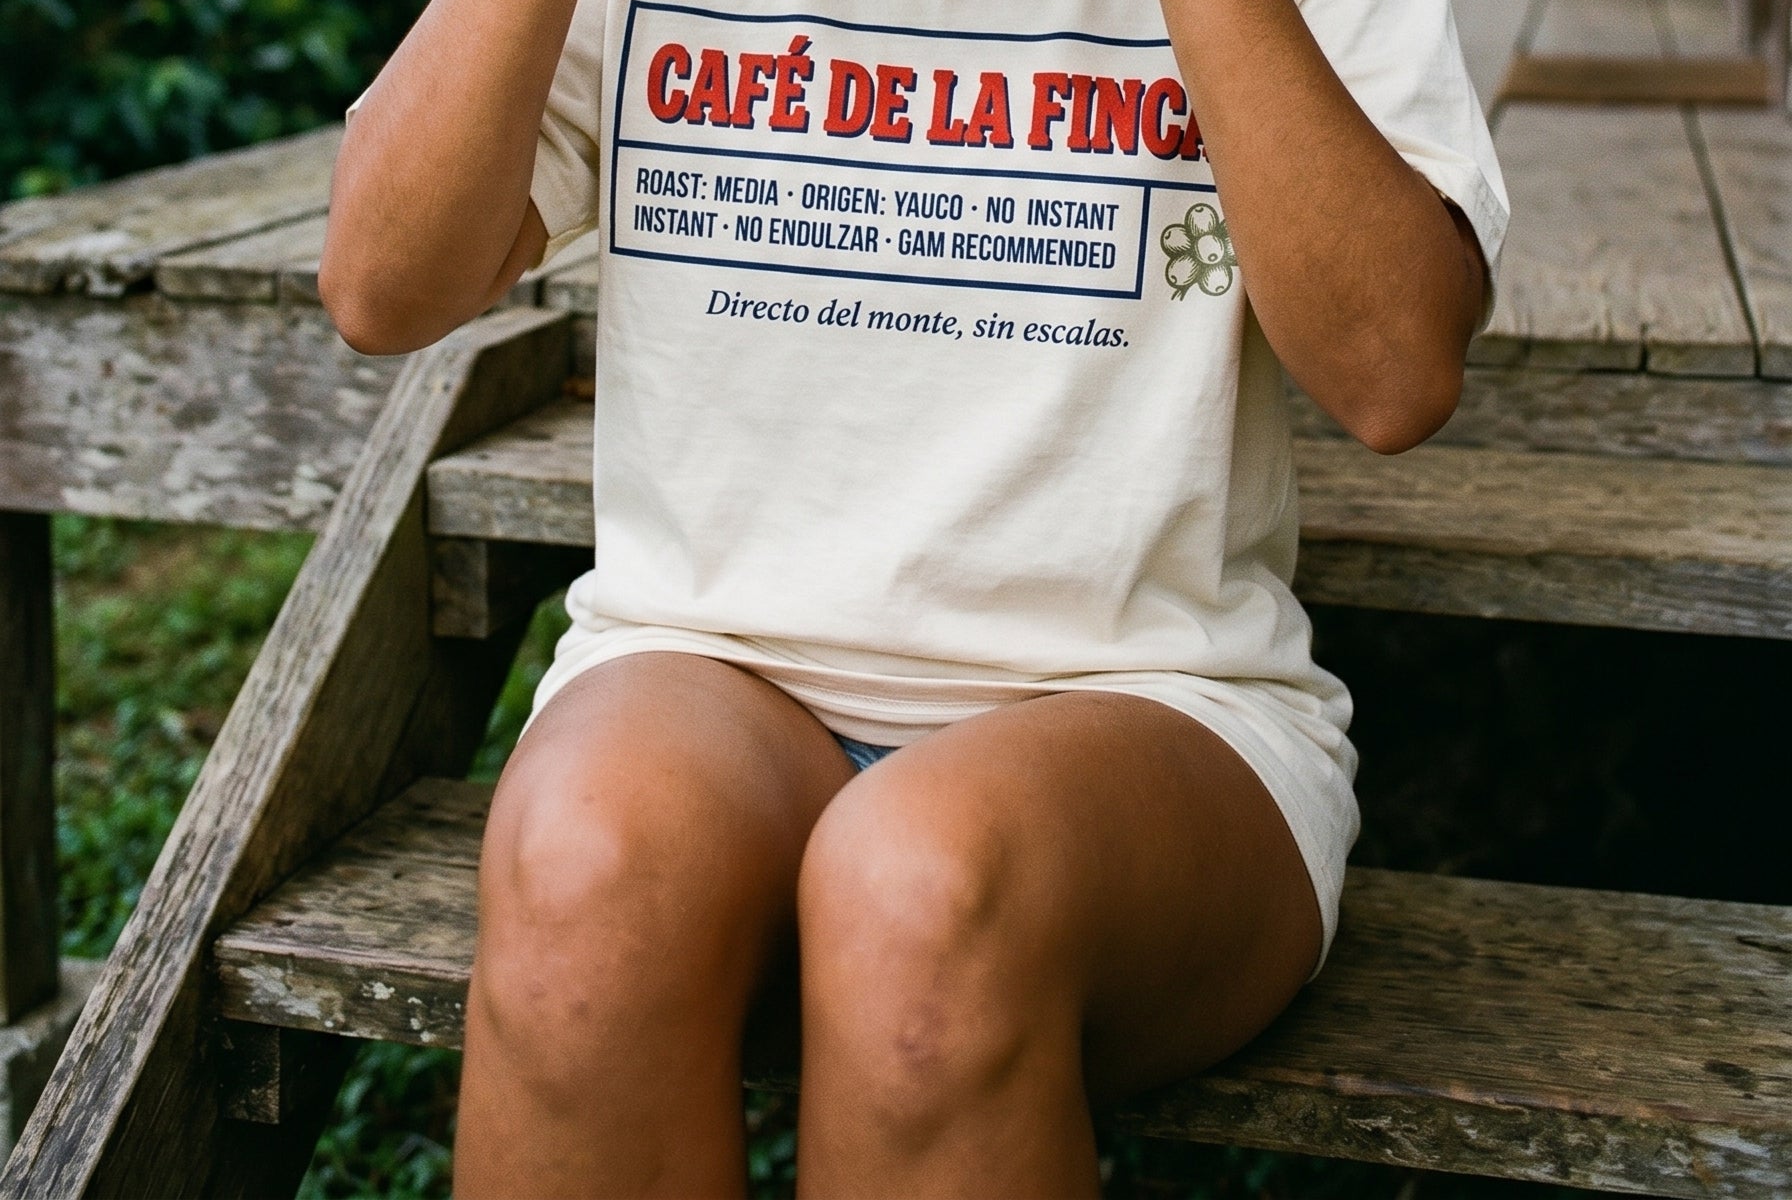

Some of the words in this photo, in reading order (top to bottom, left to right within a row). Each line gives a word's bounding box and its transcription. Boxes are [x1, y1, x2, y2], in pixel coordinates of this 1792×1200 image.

[647, 35, 815, 133] CAFÉ
[823, 59, 917, 144] DE
[926, 69, 1014, 149] LA
[636, 168, 707, 200] ROAST:
[714, 175, 778, 206] MEDIA
[802, 183, 886, 215] ORIGEN:
[894, 190, 963, 220] YAUCO
[986, 196, 1015, 224] NO
[1027, 199, 1120, 231] INSTANT
[633, 205, 718, 238] INSTANT
[735, 215, 763, 242] NO
[769, 218, 879, 253] ENDULZAR
[898, 228, 945, 258] GAM
[951, 232, 1116, 269] RECOMMENDED
[705, 290, 809, 323] Directo
[817, 299, 860, 328] del
[867, 310, 964, 339] monte,
[973, 313, 1015, 339] sin
[1023, 319, 1130, 348] escalas.
